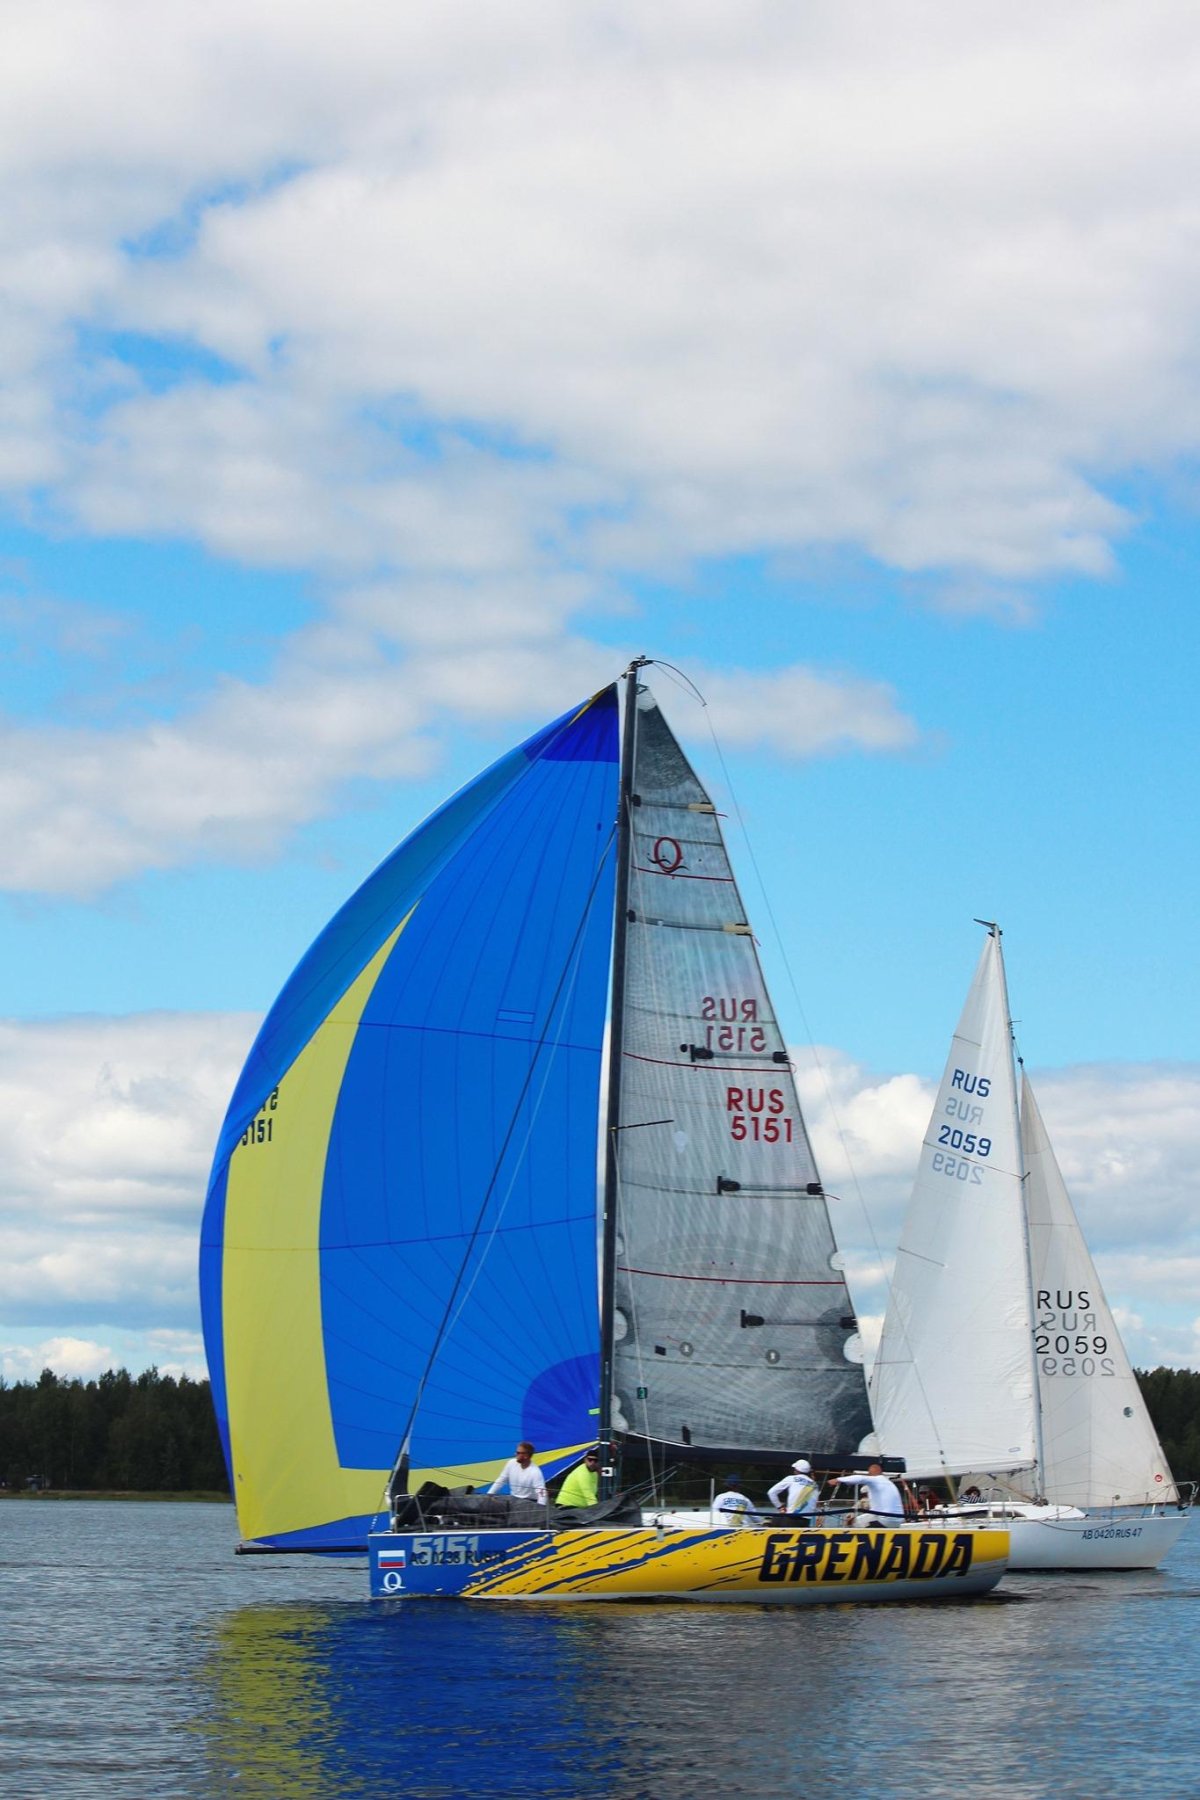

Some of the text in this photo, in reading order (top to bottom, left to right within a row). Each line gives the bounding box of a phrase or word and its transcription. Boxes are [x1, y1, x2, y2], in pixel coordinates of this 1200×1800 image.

[951, 1068, 992, 1098] RUS
[726, 1087, 785, 1114] RUS
[730, 1116, 793, 1144] 5151
[937, 1124, 992, 1158] 2059
[1036, 1290, 1090, 1310] RUS
[1035, 1335, 1108, 1355] 2059
[1094, 1529, 1115, 1539] 0420
[1114, 1528, 1131, 1539] RUS
[1131, 1527, 1143, 1538] 47
[412, 1535, 480, 1567] 5151
[758, 1533, 973, 1582] GRENADA
[379, 1571, 406, 1592] Q
